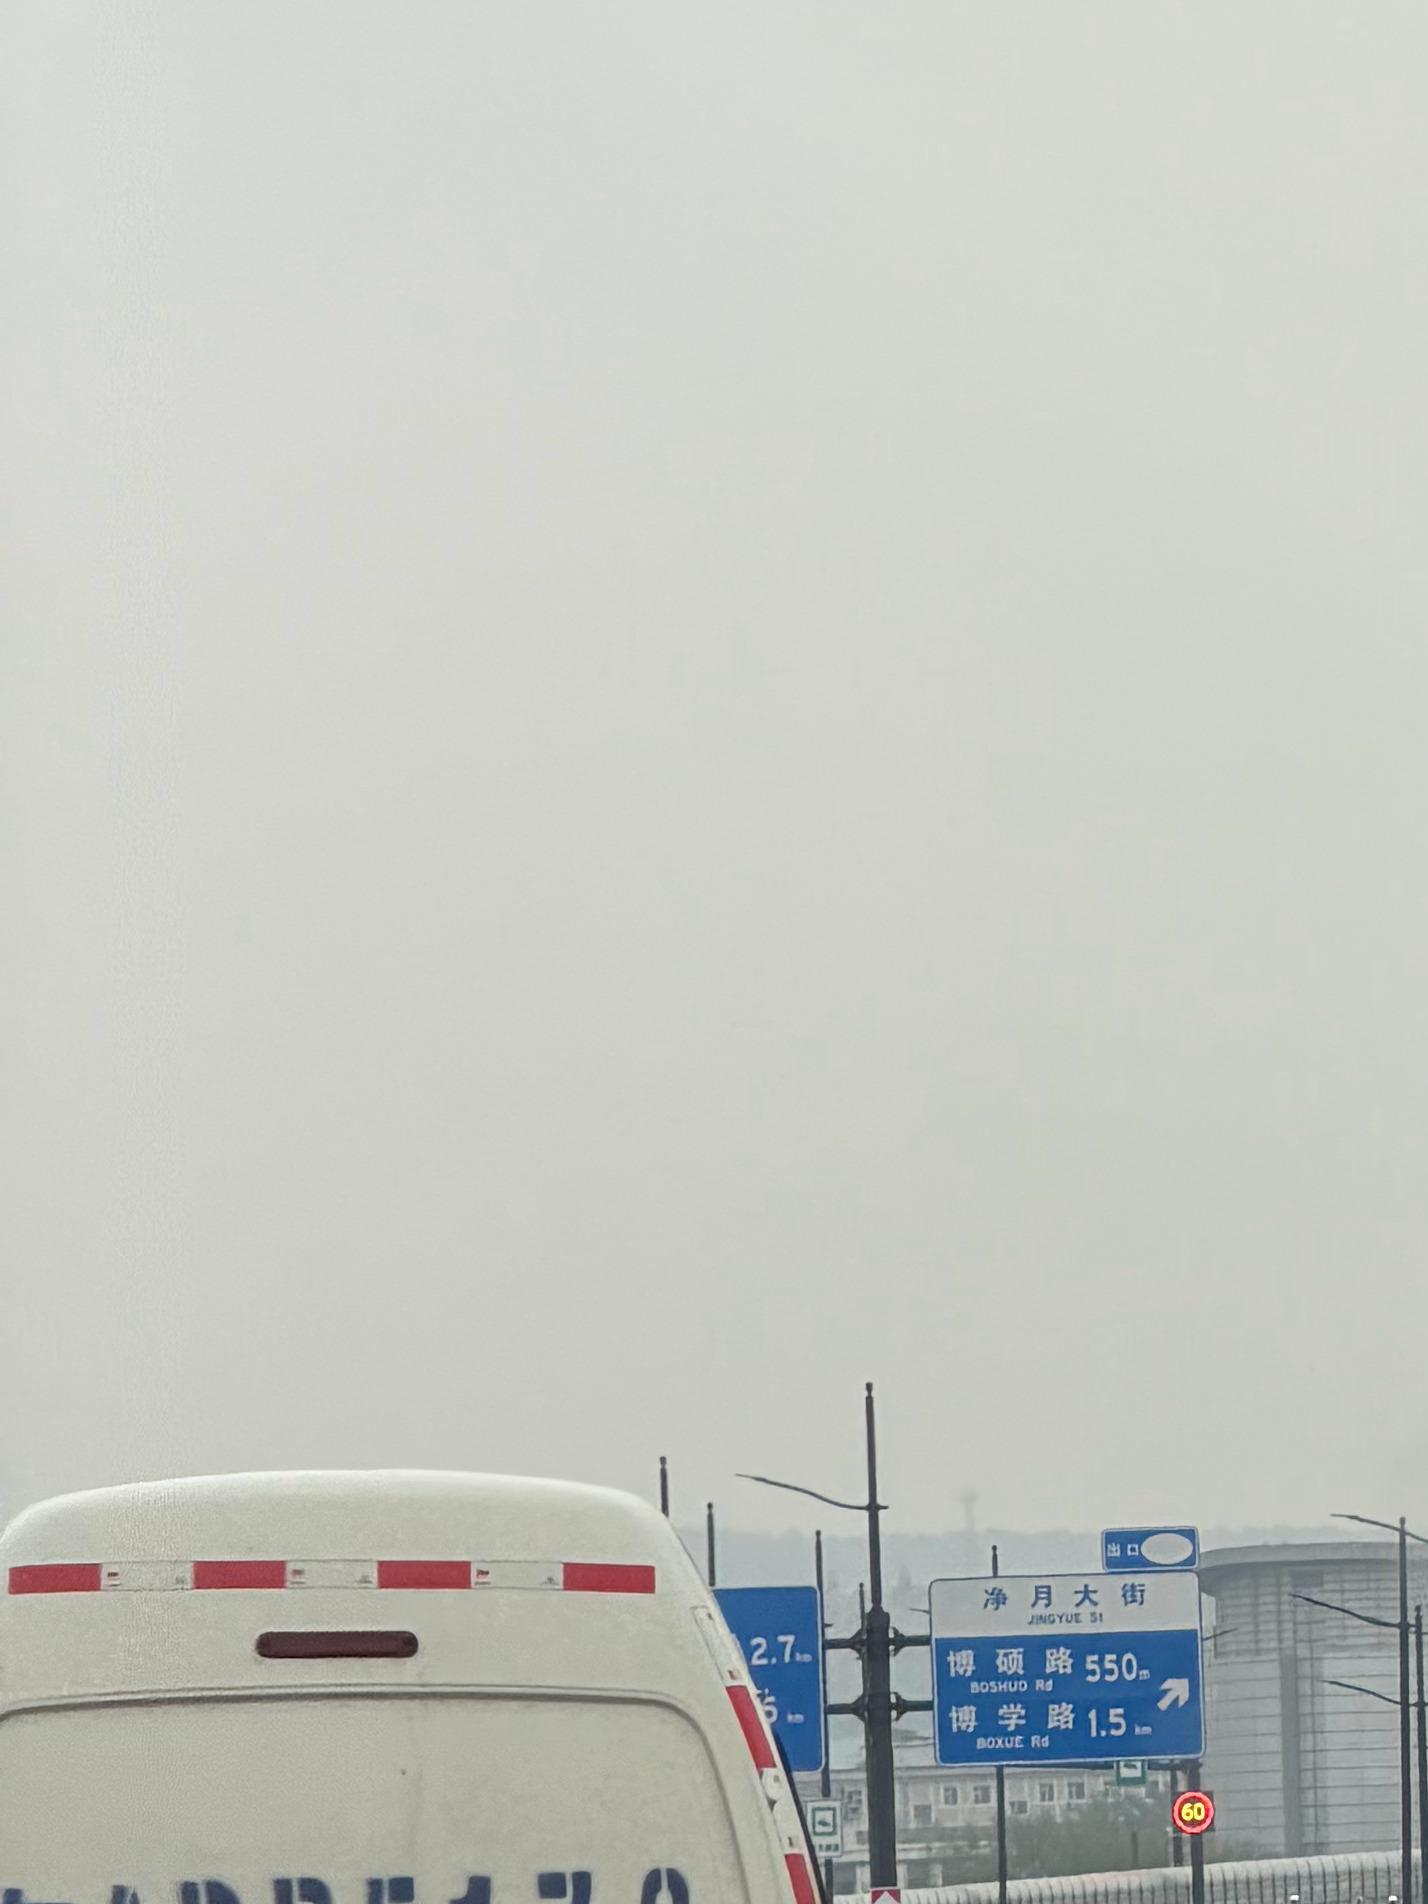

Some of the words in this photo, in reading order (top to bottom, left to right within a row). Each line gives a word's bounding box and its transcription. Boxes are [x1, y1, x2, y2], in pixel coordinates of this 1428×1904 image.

[1106, 1543, 1140, 1557] 出口
[983, 1581, 1147, 1612] 净月大街
[947, 1646, 1075, 1678] 博硕路
[1035, 1679, 1054, 1693] Rd
[949, 1702, 1077, 1734] 博学路
[976, 1736, 1025, 1750] BOXUE
[1031, 1734, 1050, 1748] Rd
[1181, 1802, 1206, 1822] 60
